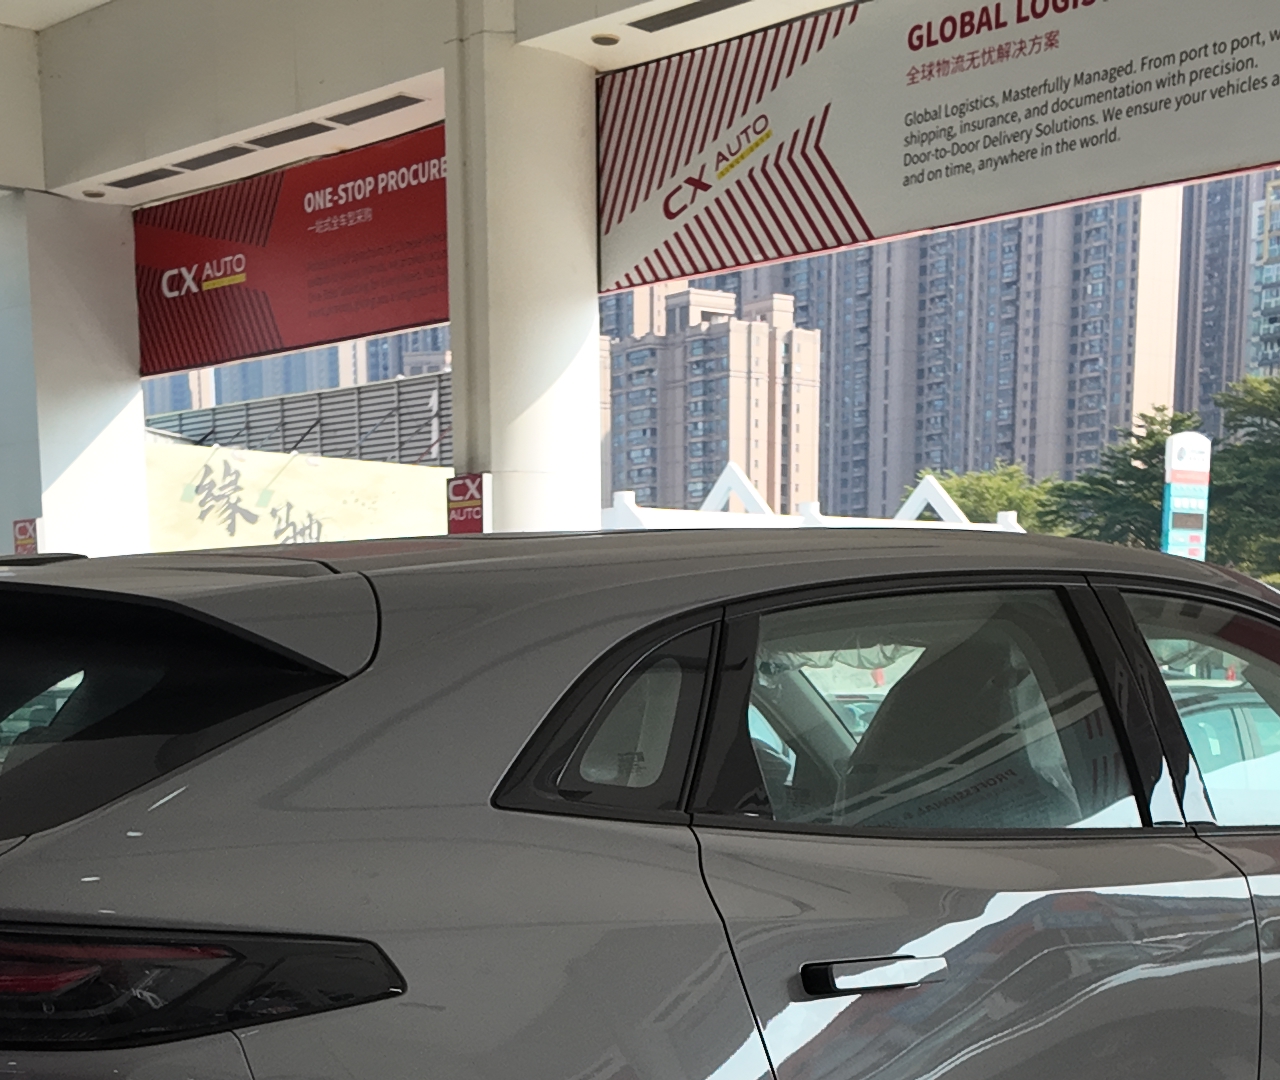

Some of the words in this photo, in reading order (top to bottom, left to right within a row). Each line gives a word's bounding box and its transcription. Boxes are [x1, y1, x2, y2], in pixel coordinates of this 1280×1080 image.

[907, 3, 1008, 51] GLOBAL
[904, 104, 942, 127] Global
[944, 95, 999, 118] Logistics,
[1002, 75, 1070, 104] Masterfully
[1073, 60, 1137, 87] Managed.
[1140, 52, 1175, 72] From
[1179, 43, 1209, 66] port
[1213, 41, 1227, 55] to
[1230, 31, 1266, 54] port,
[906, 30, 1060, 86] 全球物流无忧解决方案
[903, 124, 957, 148] shipping,
[960, 109, 1022, 135] insurance,
[1024, 101, 1048, 120] and
[1051, 79, 1152, 114] documentation
[1156, 69, 1185, 90] with
[1189, 56, 1259, 87] precision.
[903, 137, 980, 167] Door-to-Door
[983, 126, 1033, 149] Delivery
[1035, 112, 1099, 137] Solutions.
[1102, 107, 1123, 123] We
[1125, 97, 1172, 118] ensure
[1174, 89, 1208, 112] your
[1210, 77, 1269, 100] vehicles
[663, 163, 713, 220] CX
[715, 114, 769, 172] AUTO
[902, 169, 925, 187] and
[926, 167, 943, 182] on
[945, 160, 975, 179] time,
[978, 147, 1038, 171] anywhere
[1040, 142, 1053, 157] in
[1055, 137, 1077, 155] the
[1079, 126, 1121, 149] world.
[303, 176, 374, 213] ONE-STOP
[377, 157, 448, 194] PROCURE
[161, 264, 199, 298] CX
[201, 253, 246, 280] AUTO
[449, 478, 481, 501] CX
[450, 507, 481, 520] AUTO
